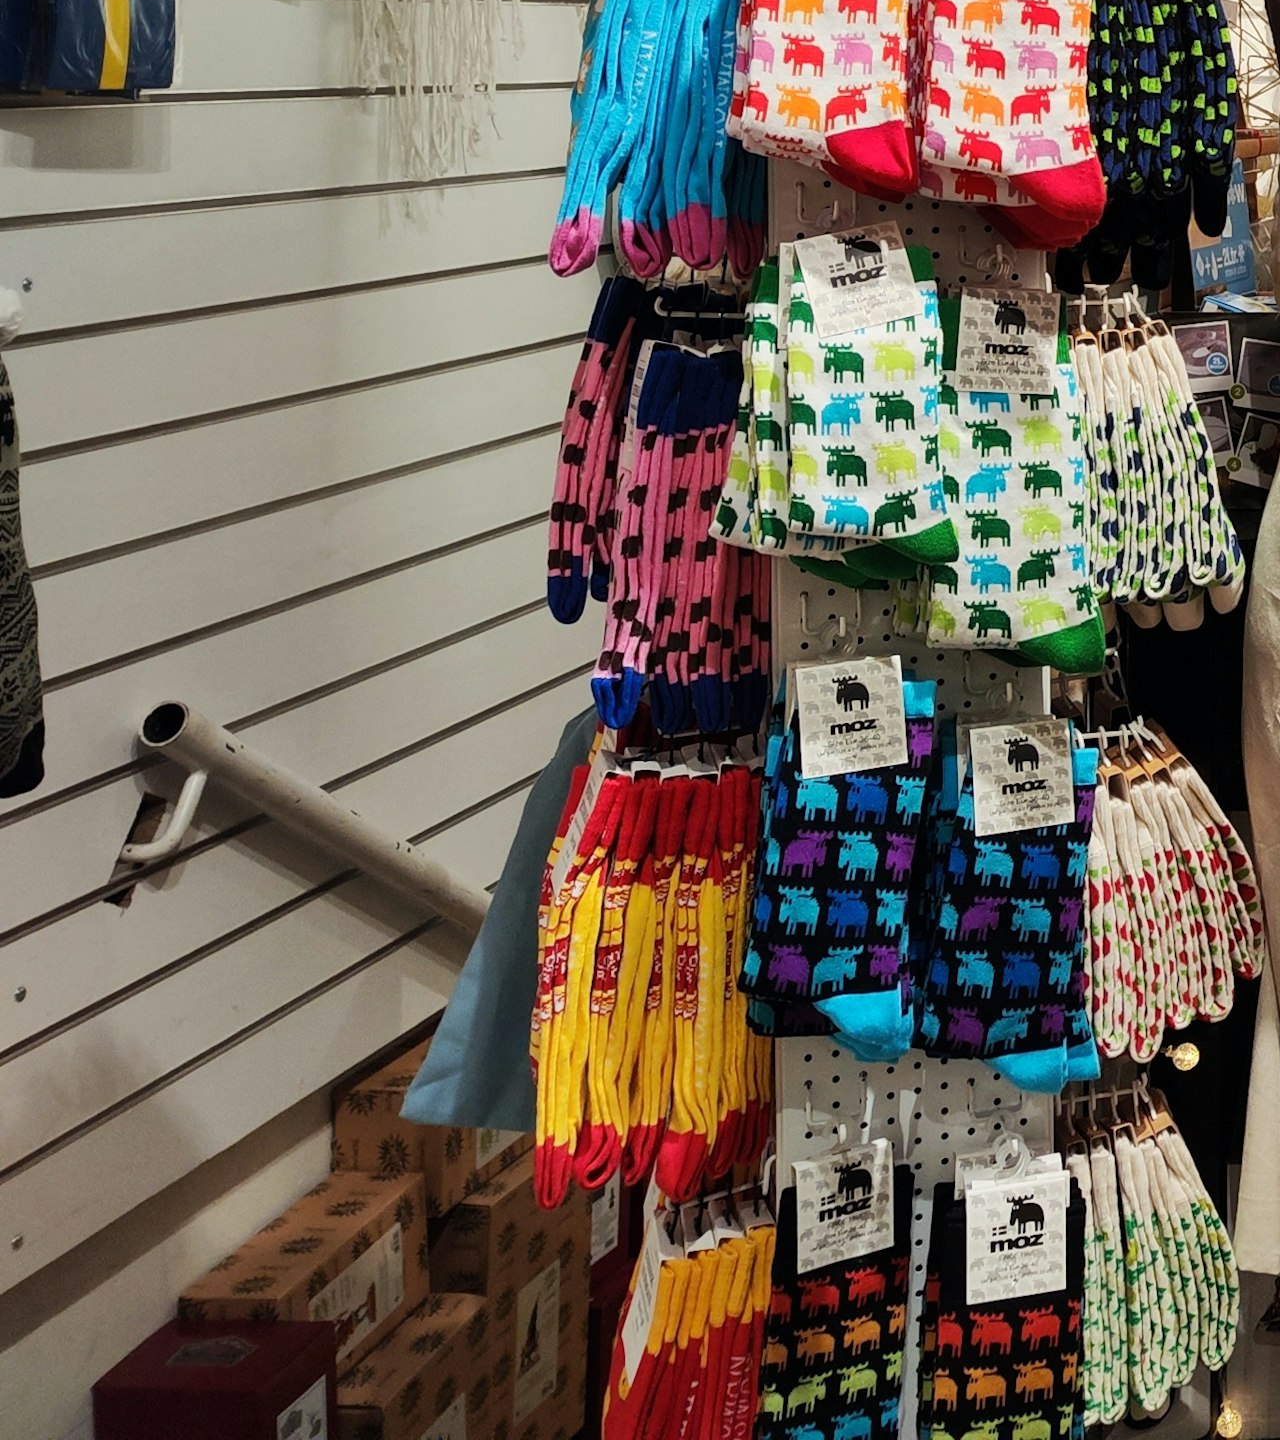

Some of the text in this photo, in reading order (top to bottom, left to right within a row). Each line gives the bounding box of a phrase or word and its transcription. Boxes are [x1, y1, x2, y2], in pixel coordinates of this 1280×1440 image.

[830, 265, 887, 289] moz
[985, 343, 1035, 356] moz
[831, 718, 880, 735] moz
[1002, 779, 1049, 796] moz
[819, 1195, 874, 1223] moz
[990, 1233, 1044, 1254] moz
